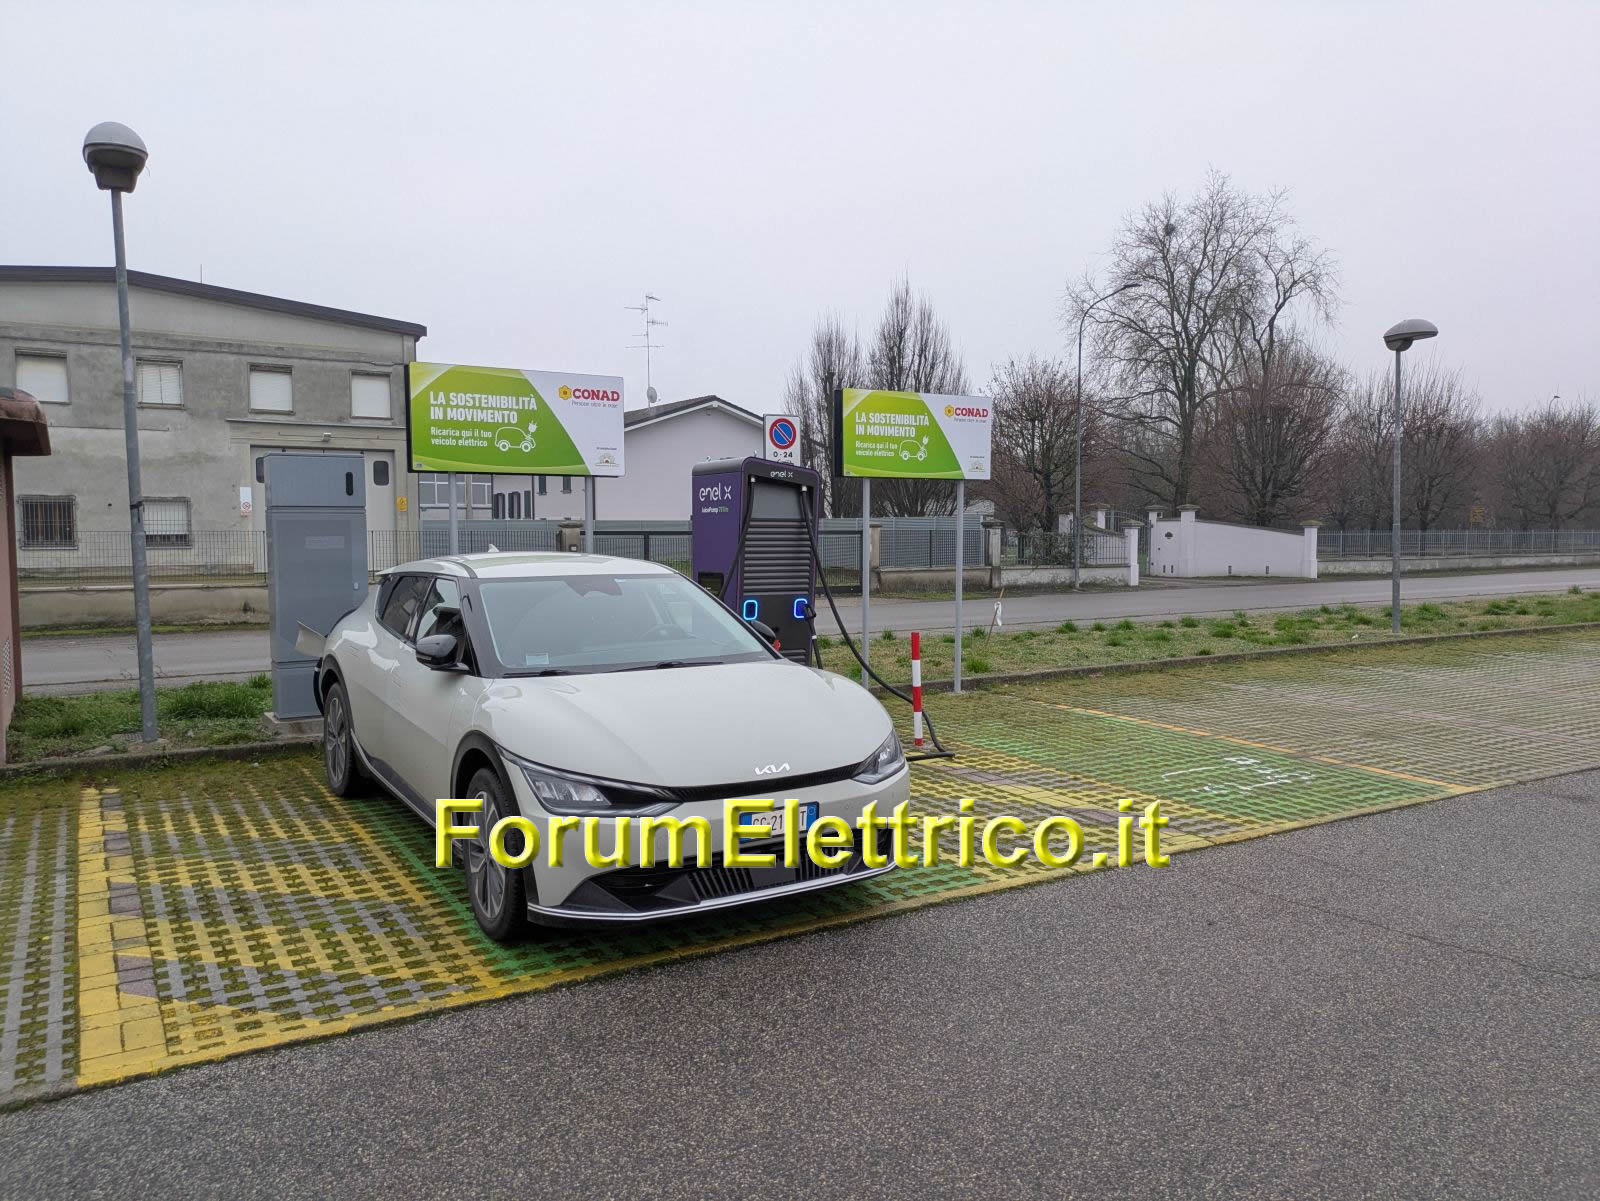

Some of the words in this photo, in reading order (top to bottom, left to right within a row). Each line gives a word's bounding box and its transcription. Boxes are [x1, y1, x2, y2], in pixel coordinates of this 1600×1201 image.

[430, 391, 446, 405] LA
[449, 392, 537, 410] SOSTENIBILITÀ
[572, 388, 620, 402] CONAD
[430, 406, 443, 420] IN
[447, 407, 518, 424] MOVIMENTO
[855, 411, 867, 423] LA
[954, 407, 989, 417] CONAD
[430, 426, 460, 437] Ricarica
[461, 429, 473, 438] qui
[481, 430, 493, 438] tuo
[855, 424, 865, 435] IN
[867, 424, 916, 437] MOVIMENTO
[431, 436, 457, 446] veicolo
[458, 438, 488, 447] elettrico
[770, 470, 787, 478] enel
[699, 482, 721, 501] enel
[754, 762, 790, 775] KIA
